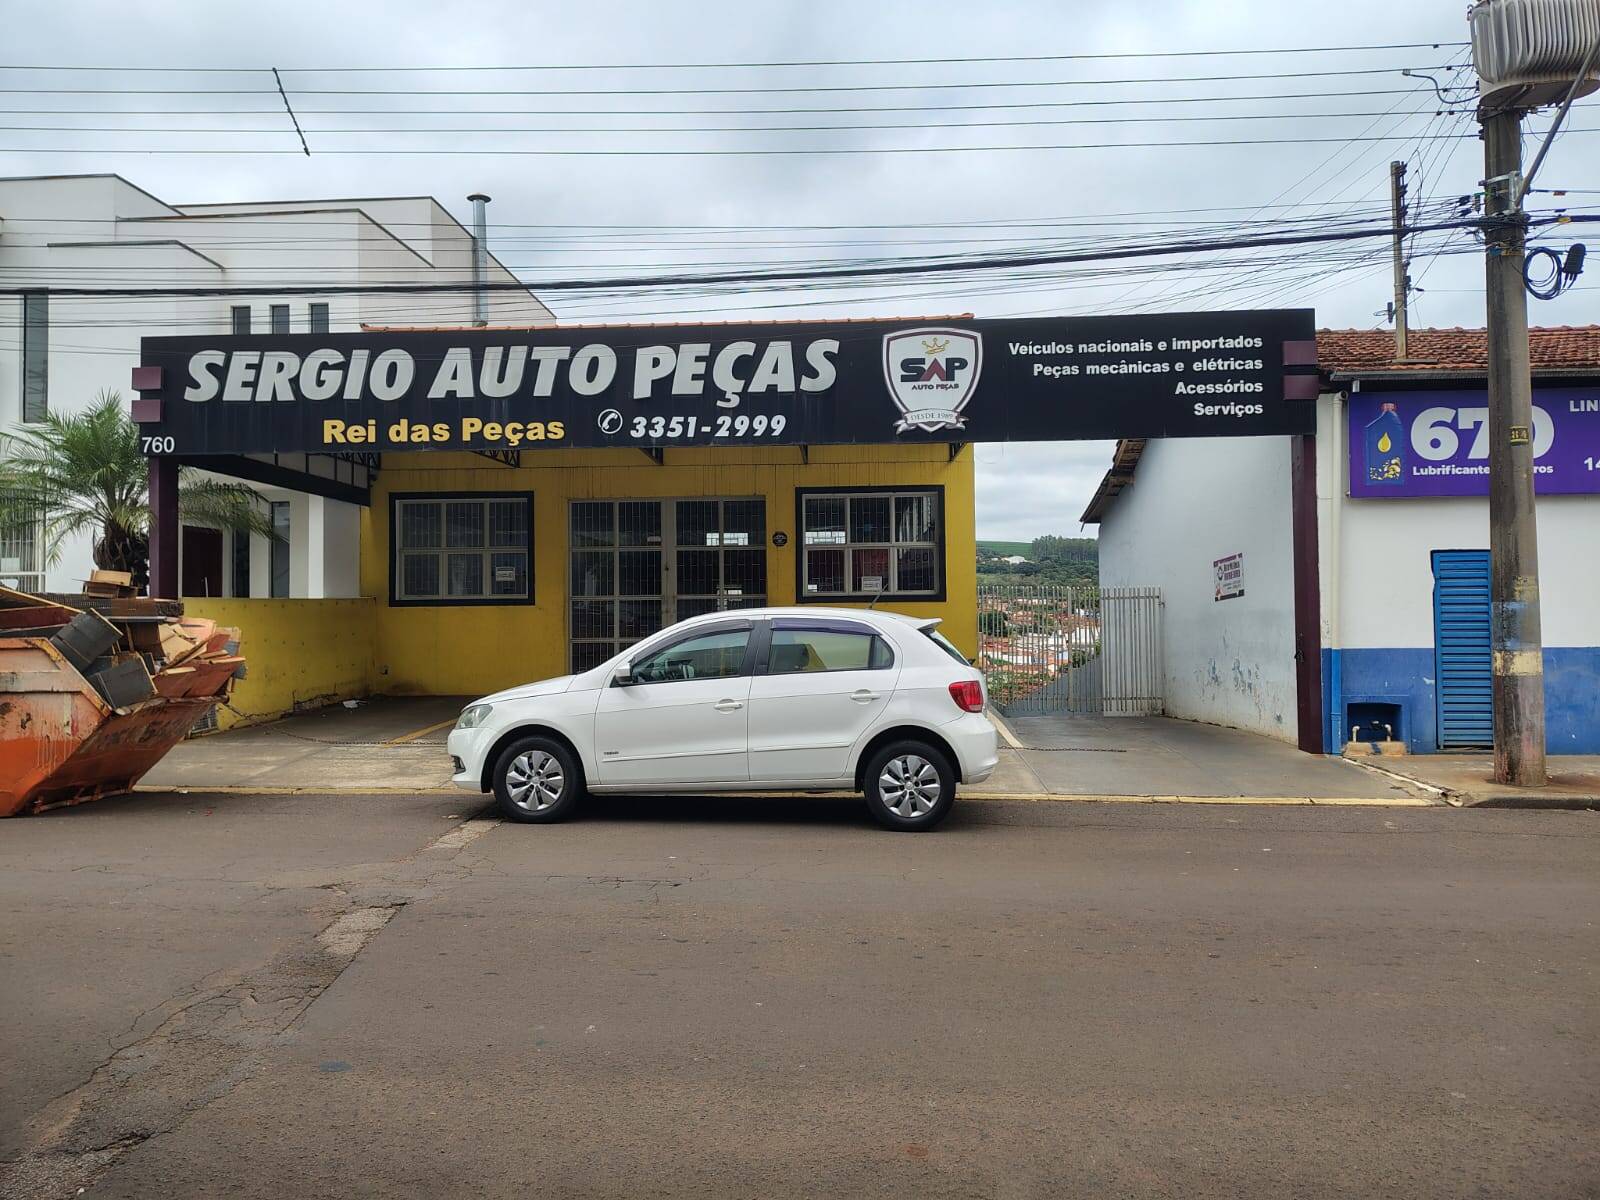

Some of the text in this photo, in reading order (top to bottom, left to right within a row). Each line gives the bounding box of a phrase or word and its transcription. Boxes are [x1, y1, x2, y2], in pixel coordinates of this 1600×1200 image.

[1008, 335, 1263, 356] Veículos nacionais e importados
[184, 338, 840, 408] SERGIO AUTO PEÇAS
[900, 357, 969, 383] SAP
[1033, 357, 1263, 379] Peças mecânicas e elétricas
[911, 383, 935, 391] AUTO
[1174, 378, 1264, 395] Acessórios
[1193, 401, 1264, 418] Serviços
[1569, 399, 1600, 412] LIN
[323, 417, 565, 447] Rei das Peças
[629, 414, 787, 438] 3351-2999
[141, 436, 175, 454] 760
[1412, 464, 1490, 476] Lubrificante
